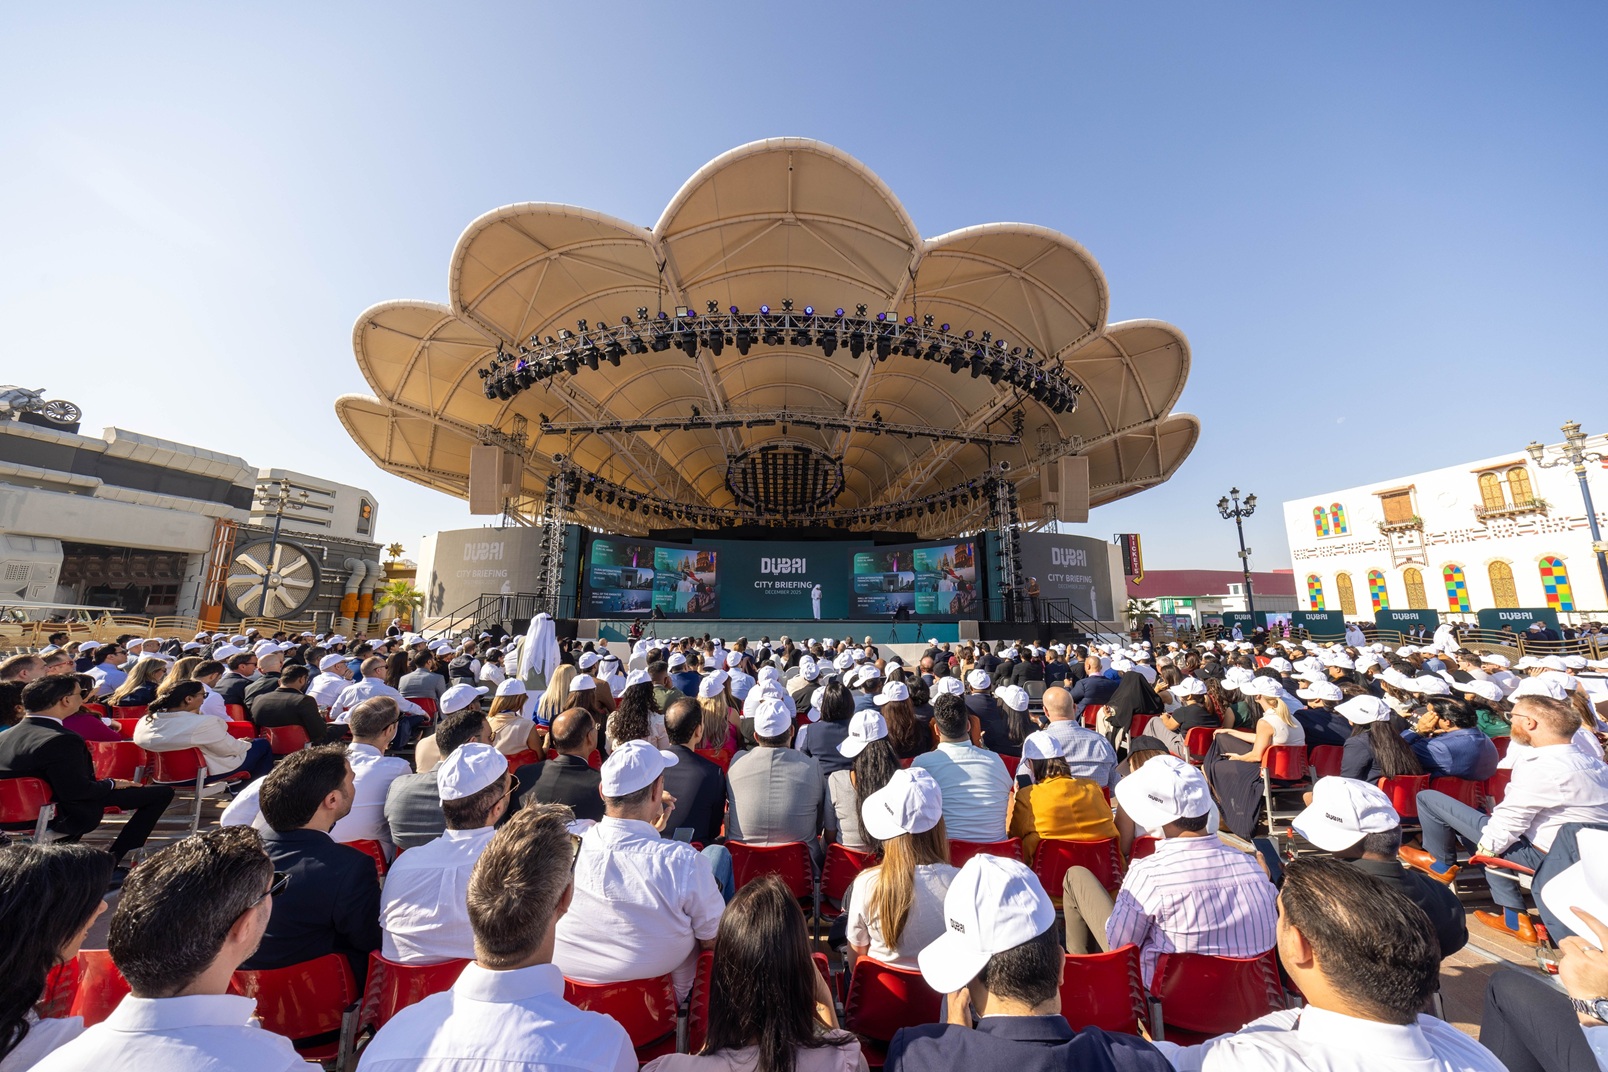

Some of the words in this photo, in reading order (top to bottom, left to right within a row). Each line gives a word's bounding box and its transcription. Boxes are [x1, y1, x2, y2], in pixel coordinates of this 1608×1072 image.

[463, 542, 505, 563] DUBAI
[1130, 534, 1139, 574] TICKETS
[1051, 547, 1087, 568] DUBAI
[761, 557, 807, 576] DUBAI
[456, 569, 472, 578] CITY
[472, 569, 508, 578] BRIEFING
[1047, 573, 1064, 582] CITY
[1065, 574, 1093, 584] BRIEFING
[754, 581, 773, 589] CITY
[774, 581, 813, 589] BRIEFING
[1234, 613, 1252, 621] DUBA
[1305, 613, 1328, 621] DUBAI
[1391, 612, 1419, 620] DUBAI
[1499, 612, 1534, 621] DUBAI
